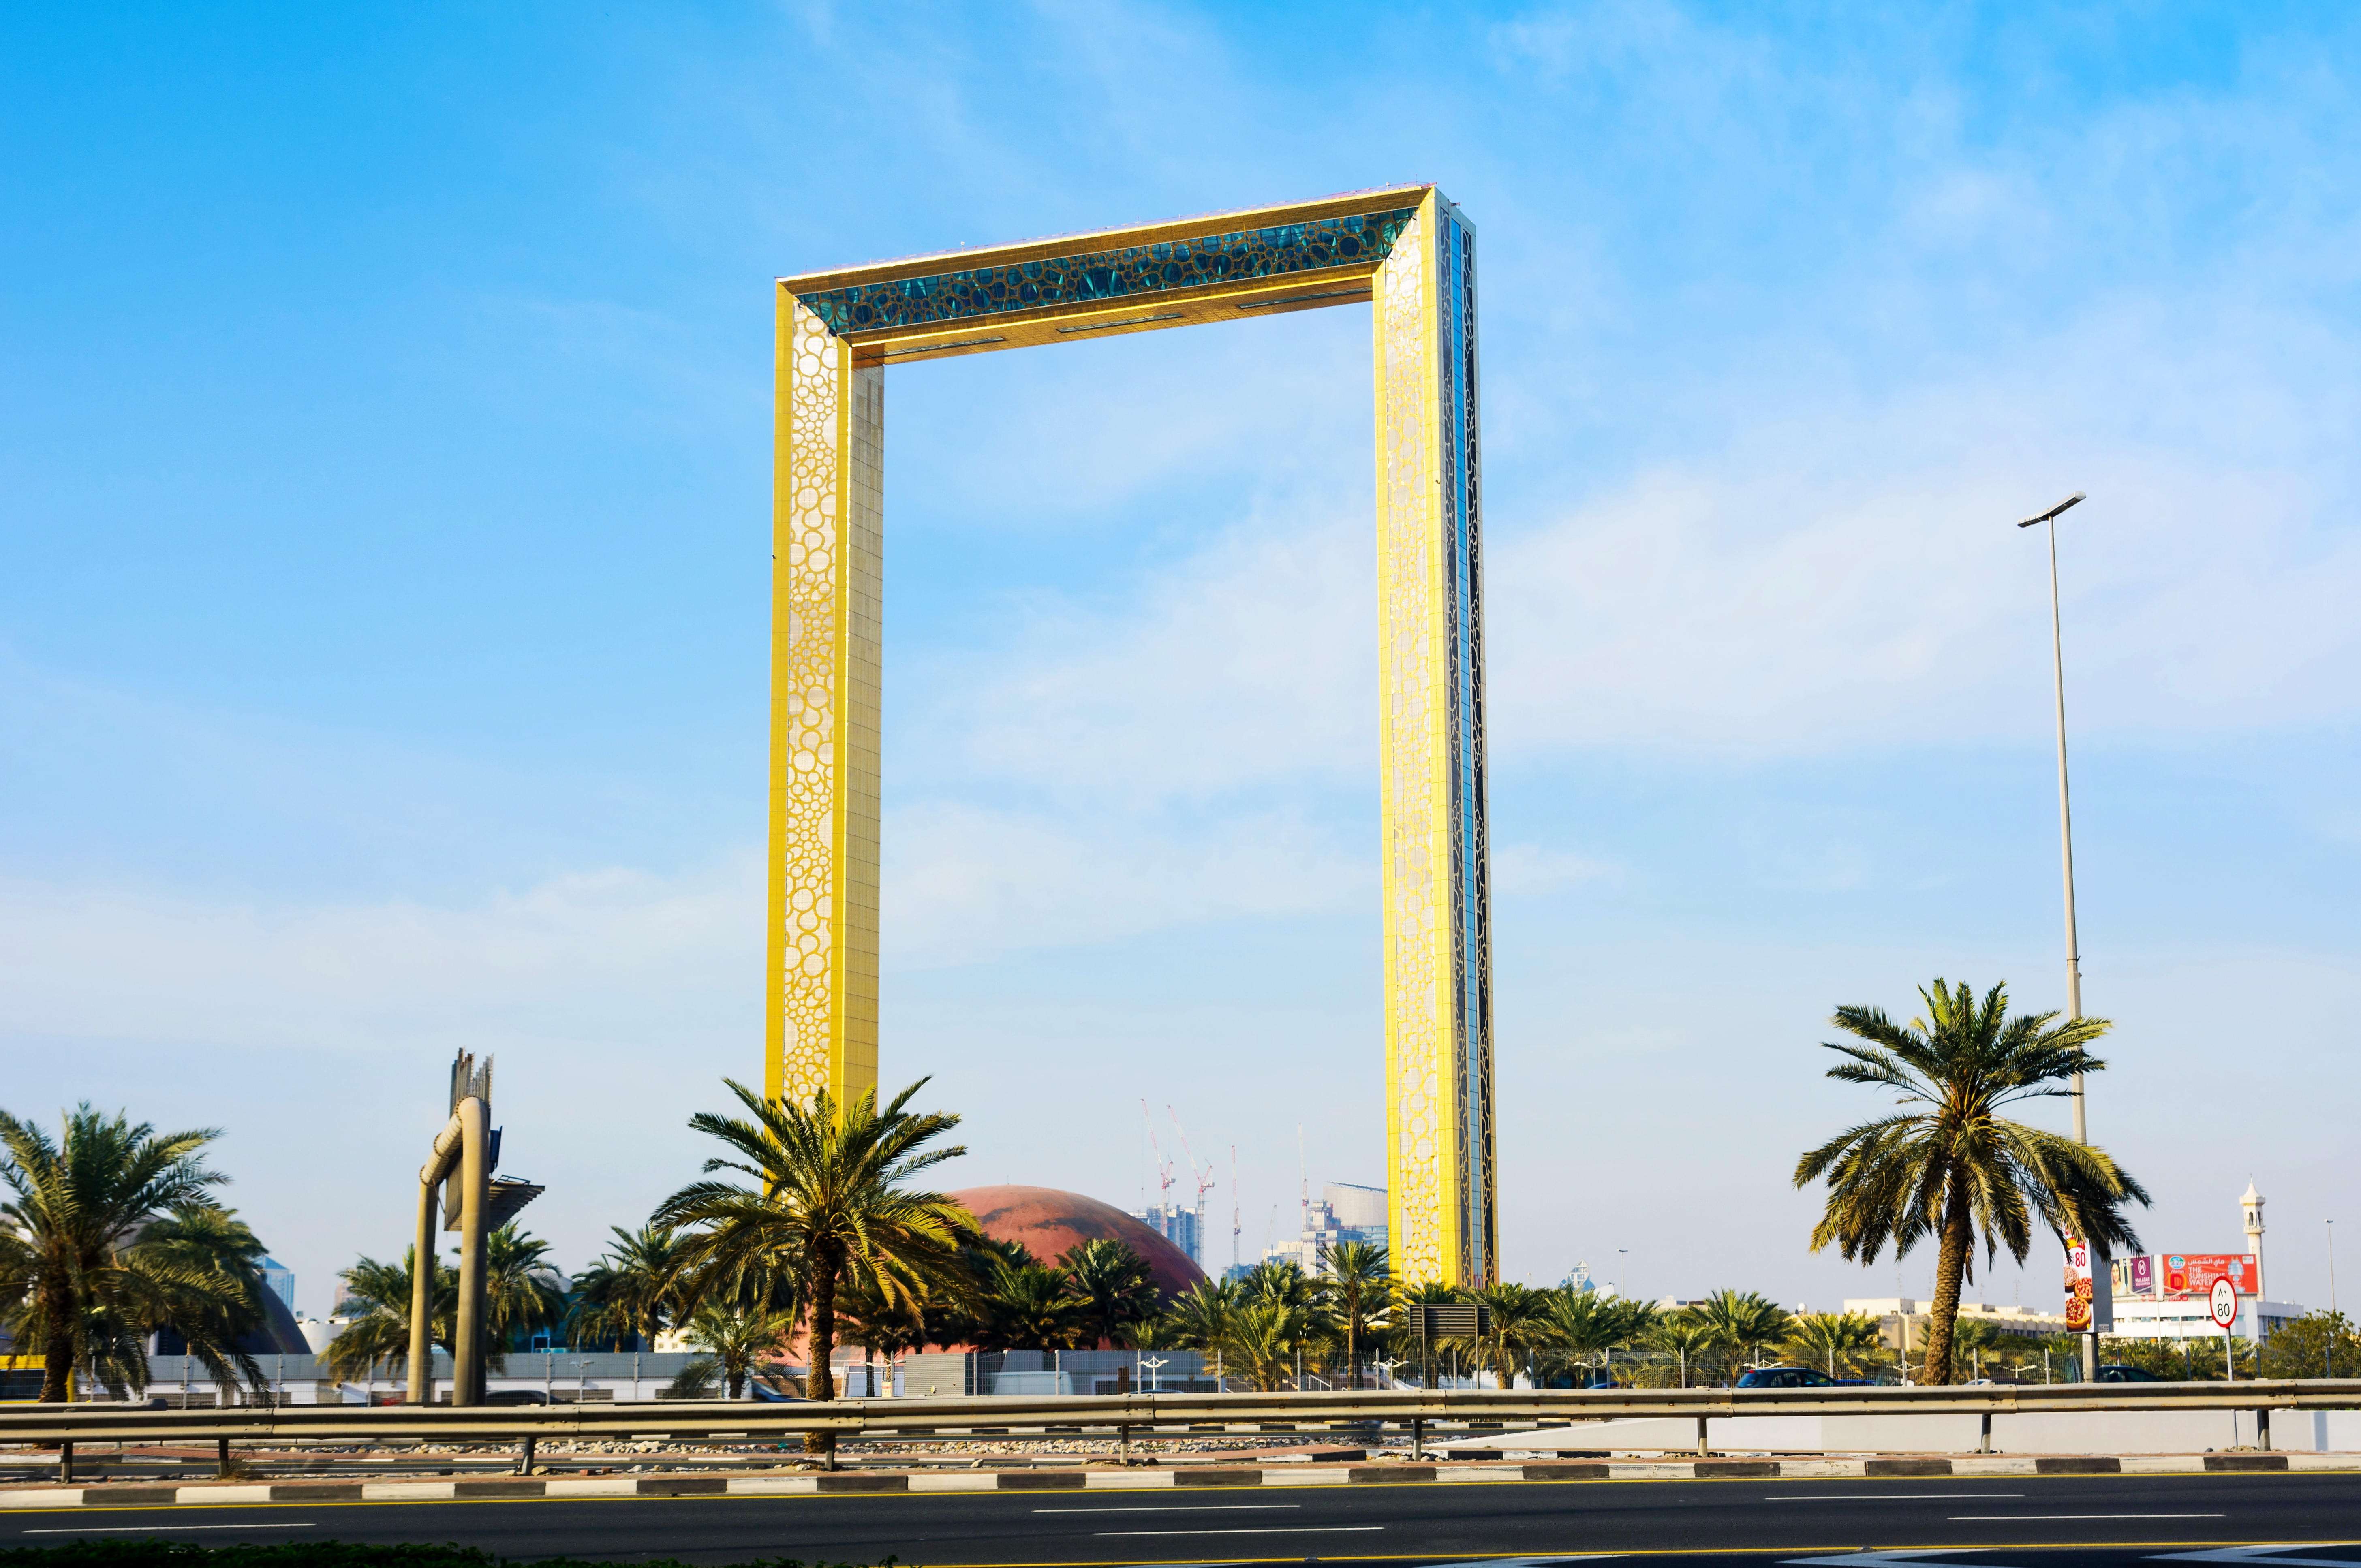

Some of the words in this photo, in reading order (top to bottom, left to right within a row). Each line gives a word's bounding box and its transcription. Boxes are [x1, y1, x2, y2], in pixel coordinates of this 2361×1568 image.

[2075, 1252, 2086, 1267] 80
[2188, 1258, 2213, 1266] الشمس
[2214, 1258, 2224, 1267] ماي
[2218, 1303, 2230, 1316] 80
